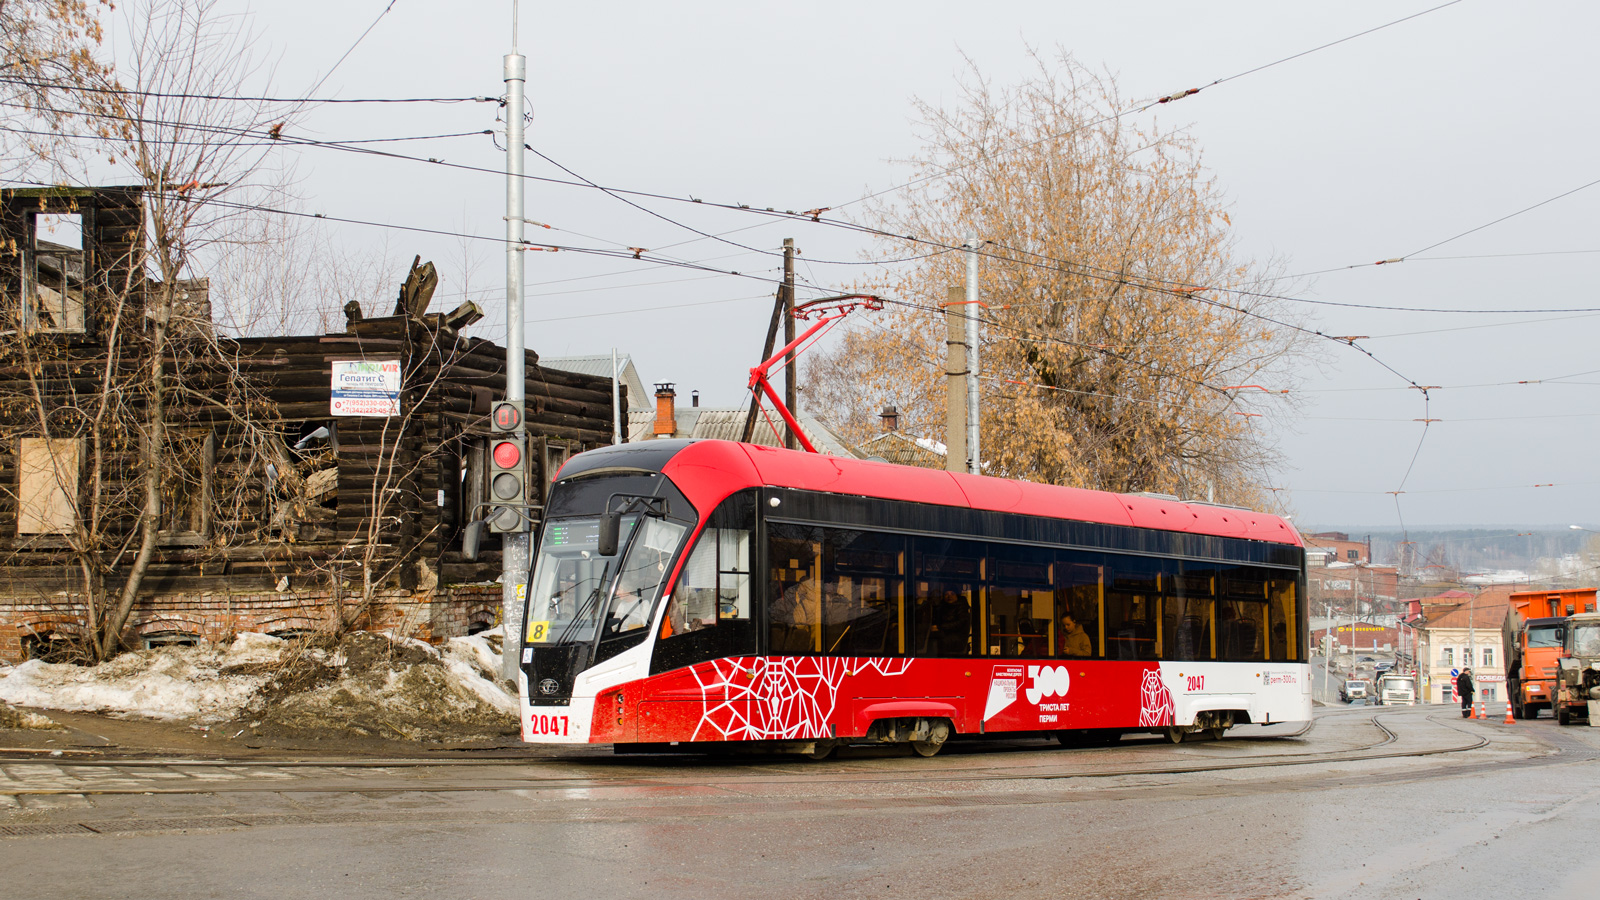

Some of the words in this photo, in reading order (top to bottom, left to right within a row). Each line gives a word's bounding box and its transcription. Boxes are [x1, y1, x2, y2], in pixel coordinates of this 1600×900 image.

[340, 374, 376, 382] Гепатит
[534, 624, 543, 639] 8
[1026, 665, 1070, 705] 300
[1187, 675, 1204, 691] 2047
[1270, 675, 1296, 685] perm-300.ru
[1039, 703, 1059, 711] ТРИСТА
[1060, 703, 1070, 711] ЛЕТ
[1039, 714, 1057, 722] ПЕРМИ
[531, 714, 569, 736] 2047
